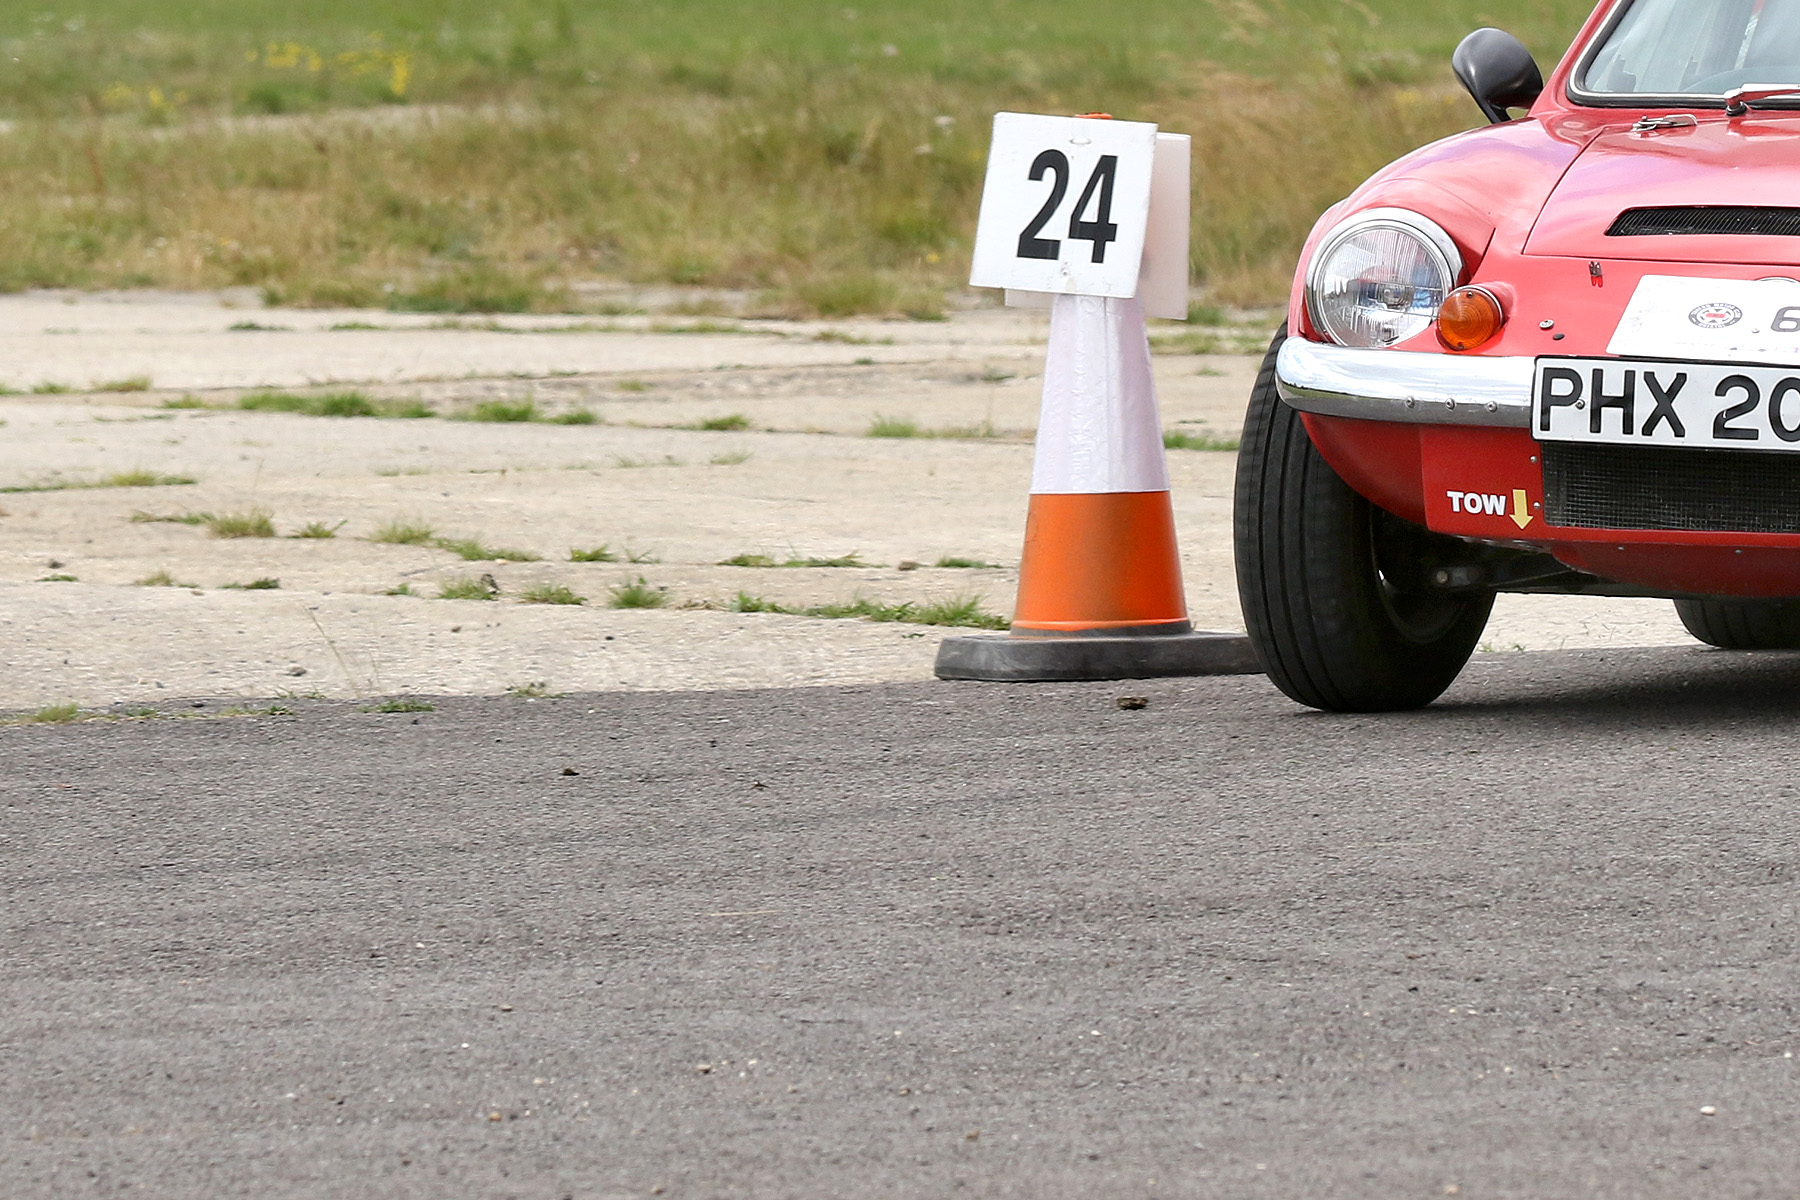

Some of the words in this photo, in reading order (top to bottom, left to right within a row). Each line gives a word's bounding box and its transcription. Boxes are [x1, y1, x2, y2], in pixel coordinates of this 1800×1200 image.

[1017, 149, 1118, 264] 24
[1540, 367, 1687, 437] PHX
[1446, 490, 1506, 516] TOW
